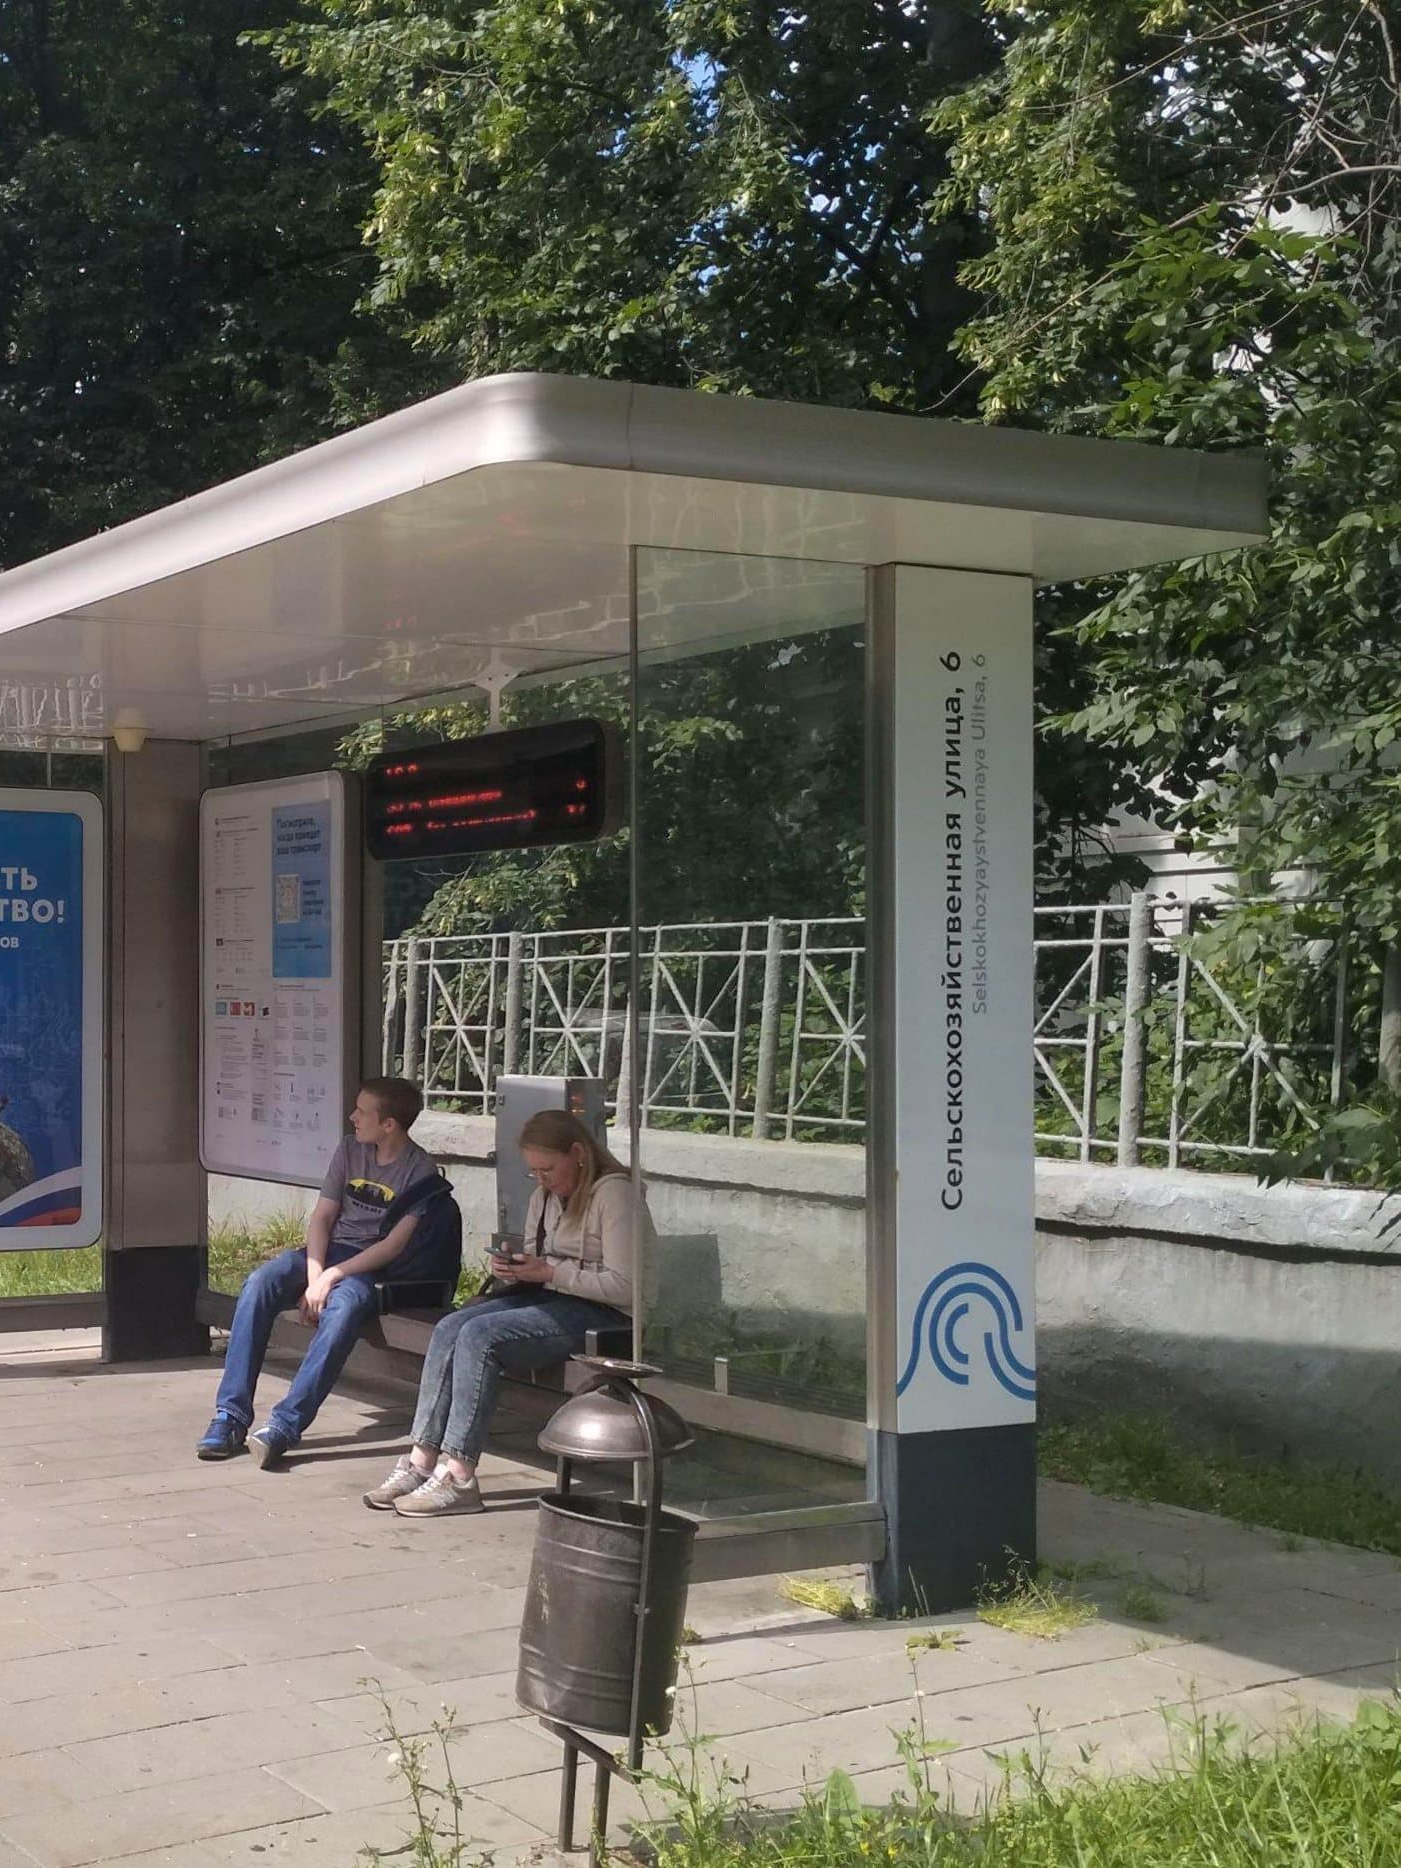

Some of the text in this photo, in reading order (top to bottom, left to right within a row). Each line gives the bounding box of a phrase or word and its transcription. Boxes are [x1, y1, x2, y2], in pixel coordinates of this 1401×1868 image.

[939, 651, 966, 1211] Сельскохозяйственная улица, 6
[970, 653, 990, 1015] Selskokhozyaystvennaya Ulitsa, 6
